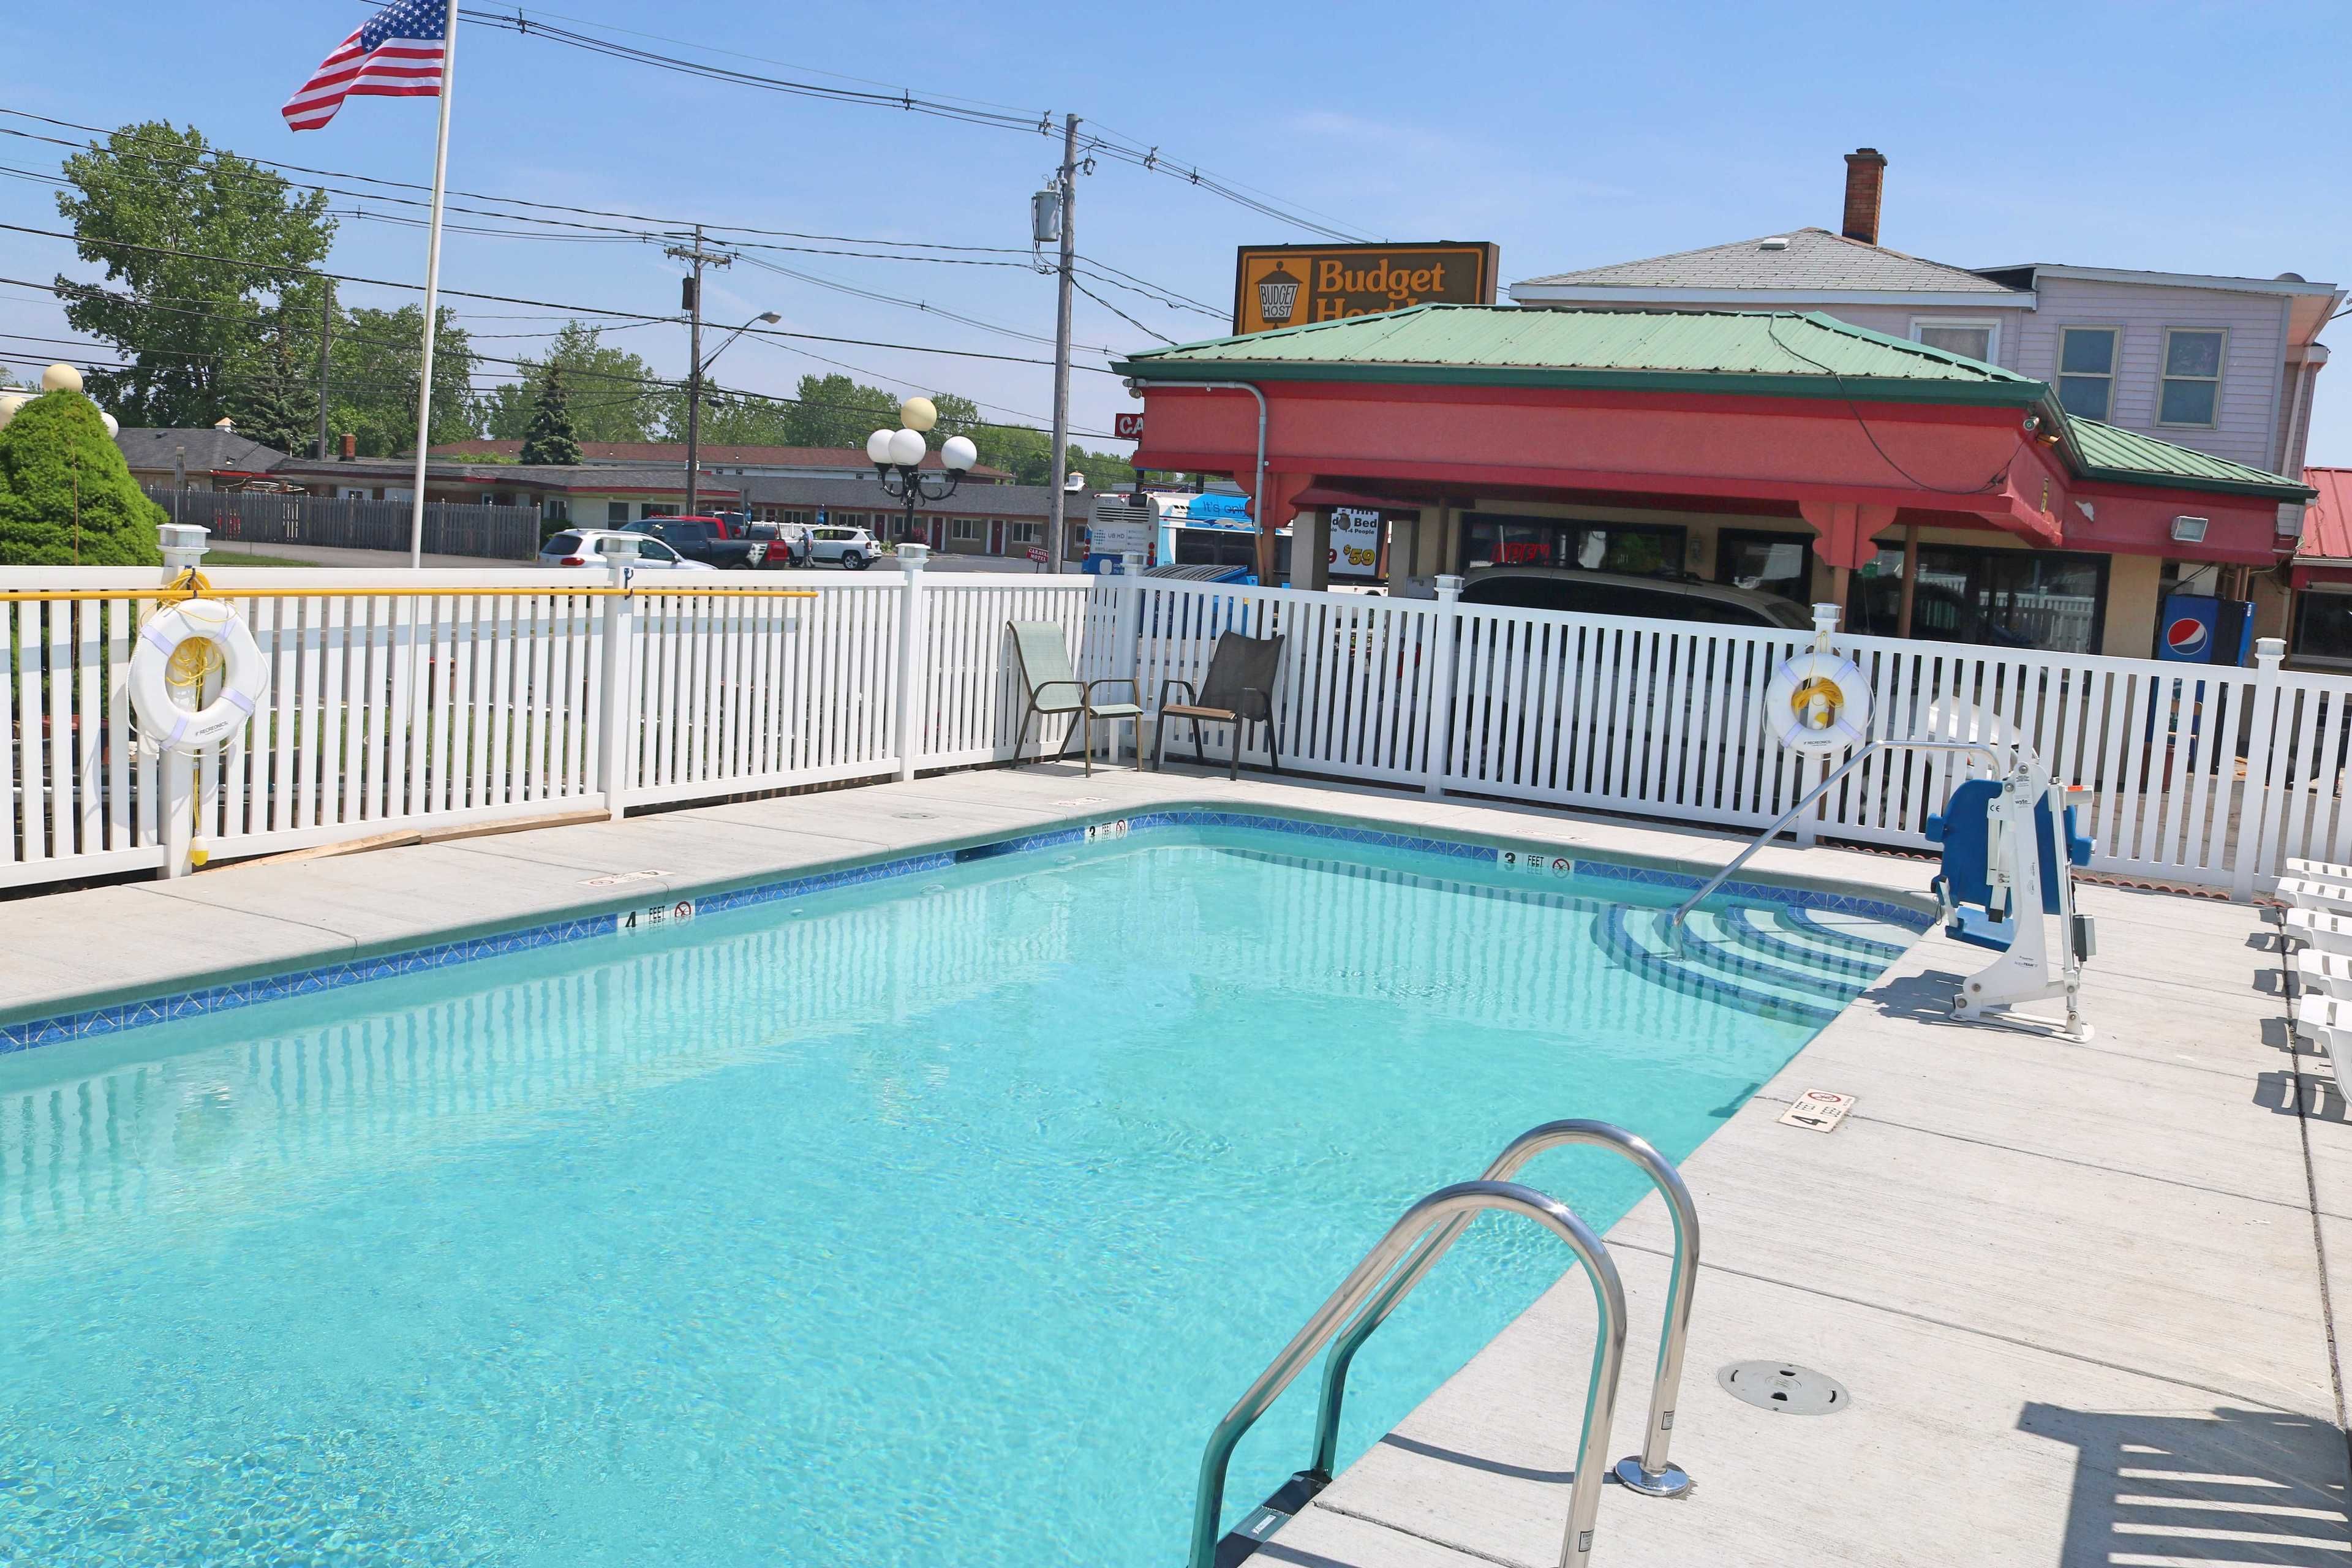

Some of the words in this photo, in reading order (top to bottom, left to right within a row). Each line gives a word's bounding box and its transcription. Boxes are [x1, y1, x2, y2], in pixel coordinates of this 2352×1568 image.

[1316, 258, 1446, 300] Budget
[1260, 285, 1297, 306] BUDGET
[1263, 306, 1291, 317] HOST
[1354, 518, 1378, 528] Bed
[1029, 548, 1048, 557] CARAVA
[1343, 544, 1376, 567] $59
[1527, 855, 1544, 867] FEET
[625, 911, 636, 927] 4
[649, 905, 666, 919] FEET
